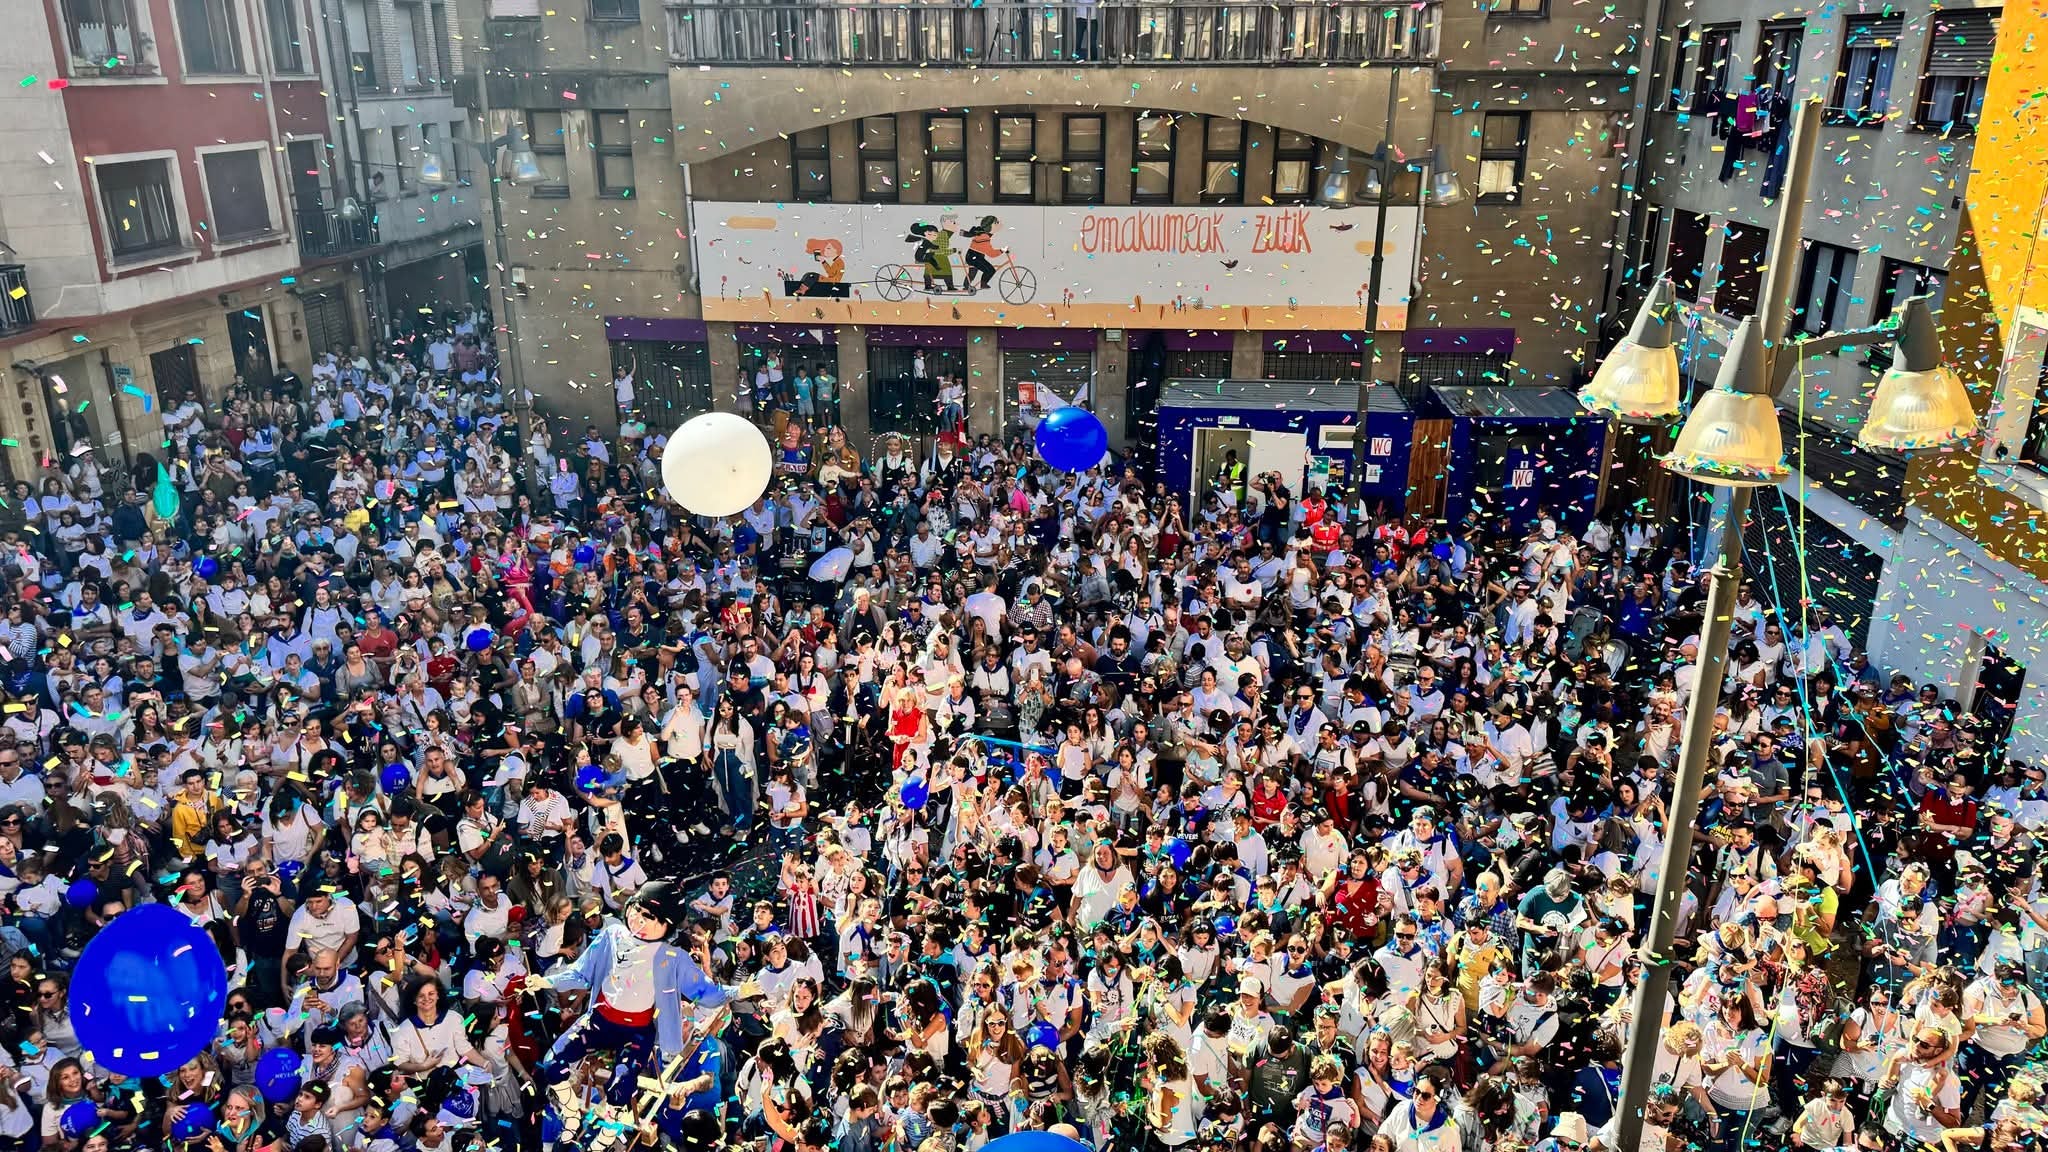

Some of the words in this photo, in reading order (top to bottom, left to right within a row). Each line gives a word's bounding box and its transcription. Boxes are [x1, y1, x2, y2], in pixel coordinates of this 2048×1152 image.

[1080, 209, 1225, 254] emakumeak
[1251, 208, 1312, 254] zutik
[1373, 438, 1391, 454] WC
[1514, 470, 1532, 486] WC
